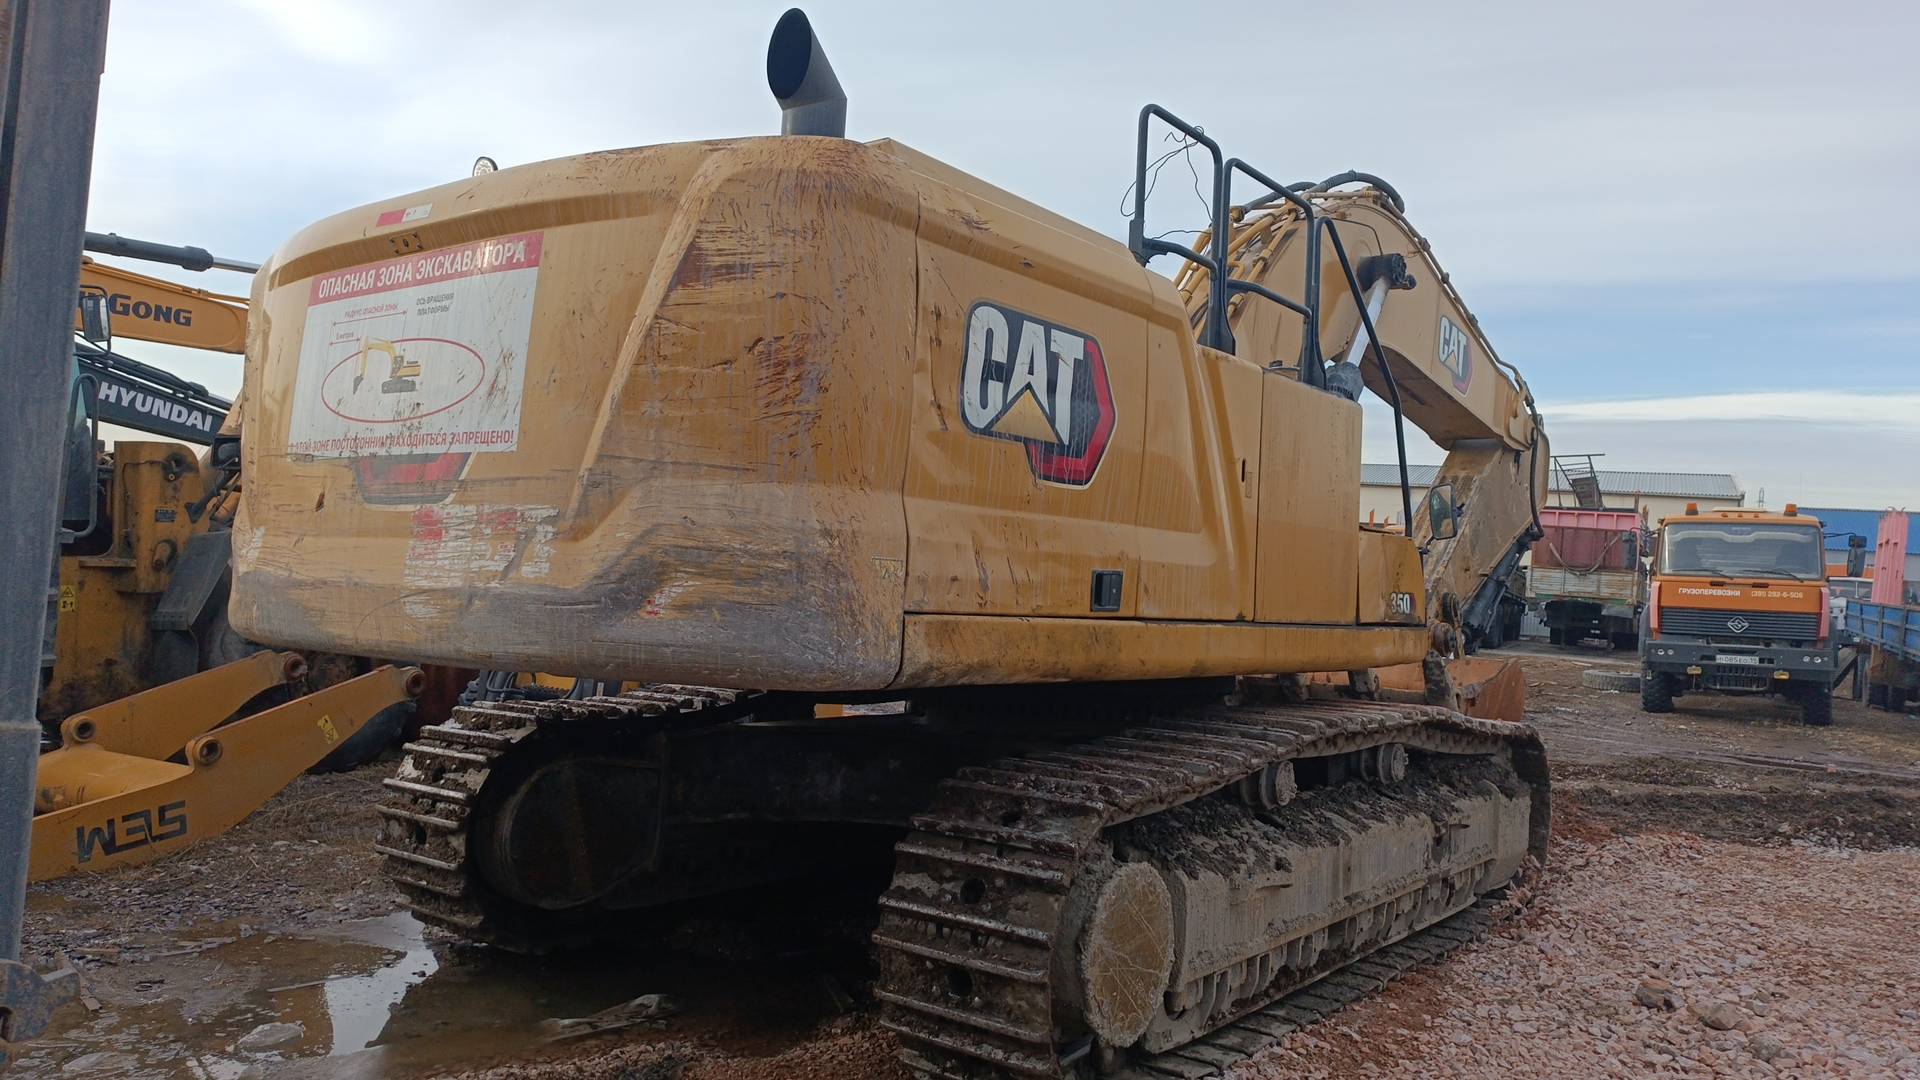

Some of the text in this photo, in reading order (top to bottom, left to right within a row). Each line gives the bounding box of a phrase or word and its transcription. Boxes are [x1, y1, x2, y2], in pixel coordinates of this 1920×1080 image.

[318, 240, 525, 299] ОПАСНАЯ ЗОНА ЭКСКАВАТОРА
[963, 304, 1084, 444] CAT
[1439, 316, 1468, 377] CAT
[98, 381, 213, 432] HYUNDAI
[449, 429, 514, 447] ЗАПРЕЩЕНО!
[1390, 592, 1411, 614] 350
